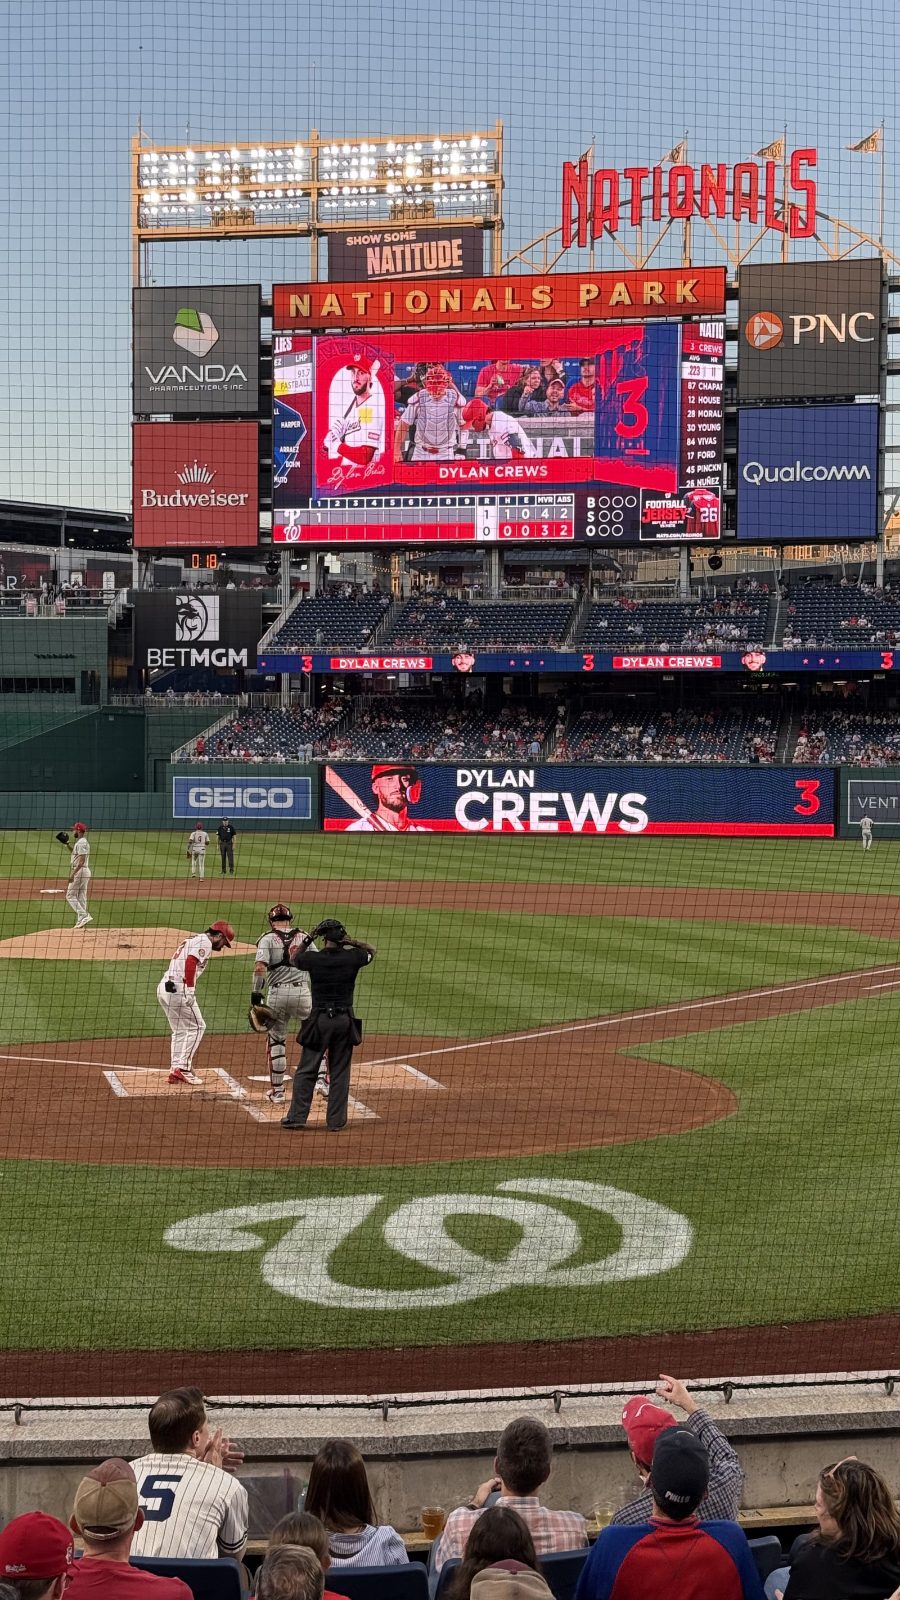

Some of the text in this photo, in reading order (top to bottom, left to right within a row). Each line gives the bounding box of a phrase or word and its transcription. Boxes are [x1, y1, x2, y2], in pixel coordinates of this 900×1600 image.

[562, 148, 816, 249] NATIONALS
[346, 230, 417, 246] SHOW SOME
[366, 238, 463, 276] NATITUDE
[289, 279, 700, 317] NATIONALS PARK
[788, 312, 875, 345] PNC
[690, 343, 722, 354] 3 CREWS
[295, 354, 308, 363] LHP
[144, 364, 248, 384] VANDA
[149, 384, 228, 392] PHARMACEUTICALS
[281, 379, 310, 390] FASTBALL
[687, 382, 696, 390] 87
[688, 395, 720, 404] 12 HOUSE
[614, 376, 649, 438] 3
[687, 410, 695, 418] 28
[281, 420, 301, 429] HARPER
[687, 423, 721, 432] 30 YOUNG
[686, 437, 717, 446] 84 VIVAS
[279, 445, 299, 453] ARRAEZ
[687, 451, 716, 460] 17 FORD
[439, 466, 548, 479] DYLAN CREWS
[686, 463, 722, 474] 45 PINCKN
[742, 460, 871, 486] Qualcomm
[697, 476, 720, 487] NUÑEZ
[141, 488, 249, 508] Budweiser
[371, 499, 377, 507] 4
[537, 496, 553, 504] MVR
[587, 497, 595, 507] B
[645, 499, 687, 509] FOOTBALL
[316, 513, 321, 523] 1
[484, 510, 489, 519] 1
[505, 509, 510, 519] 1
[521, 509, 530, 519] 0
[541, 508, 549, 518] 4
[560, 508, 568, 518] 2
[587, 511, 595, 522] S
[642, 508, 689, 524] JERSEY
[699, 507, 718, 523] 26
[483, 526, 490, 536] 0
[503, 526, 512, 536] 0
[521, 525, 530, 535] 0
[541, 525, 549, 535] 3
[560, 524, 568, 535] 2
[586, 525, 595, 536] O
[147, 648, 248, 667] BETMGM
[301, 655, 426, 672] 3 DYLAN CREWS
[582, 654, 713, 671] 3 DYLAN CREWS
[880, 652, 893, 670] 3
[456, 769, 535, 788] DYLAN
[188, 787, 294, 809] GEICO
[793, 779, 820, 816] 3
[857, 796, 899, 809] VENT
[454, 791, 649, 833] CREWS
[138, 1474, 184, 1522] 5
